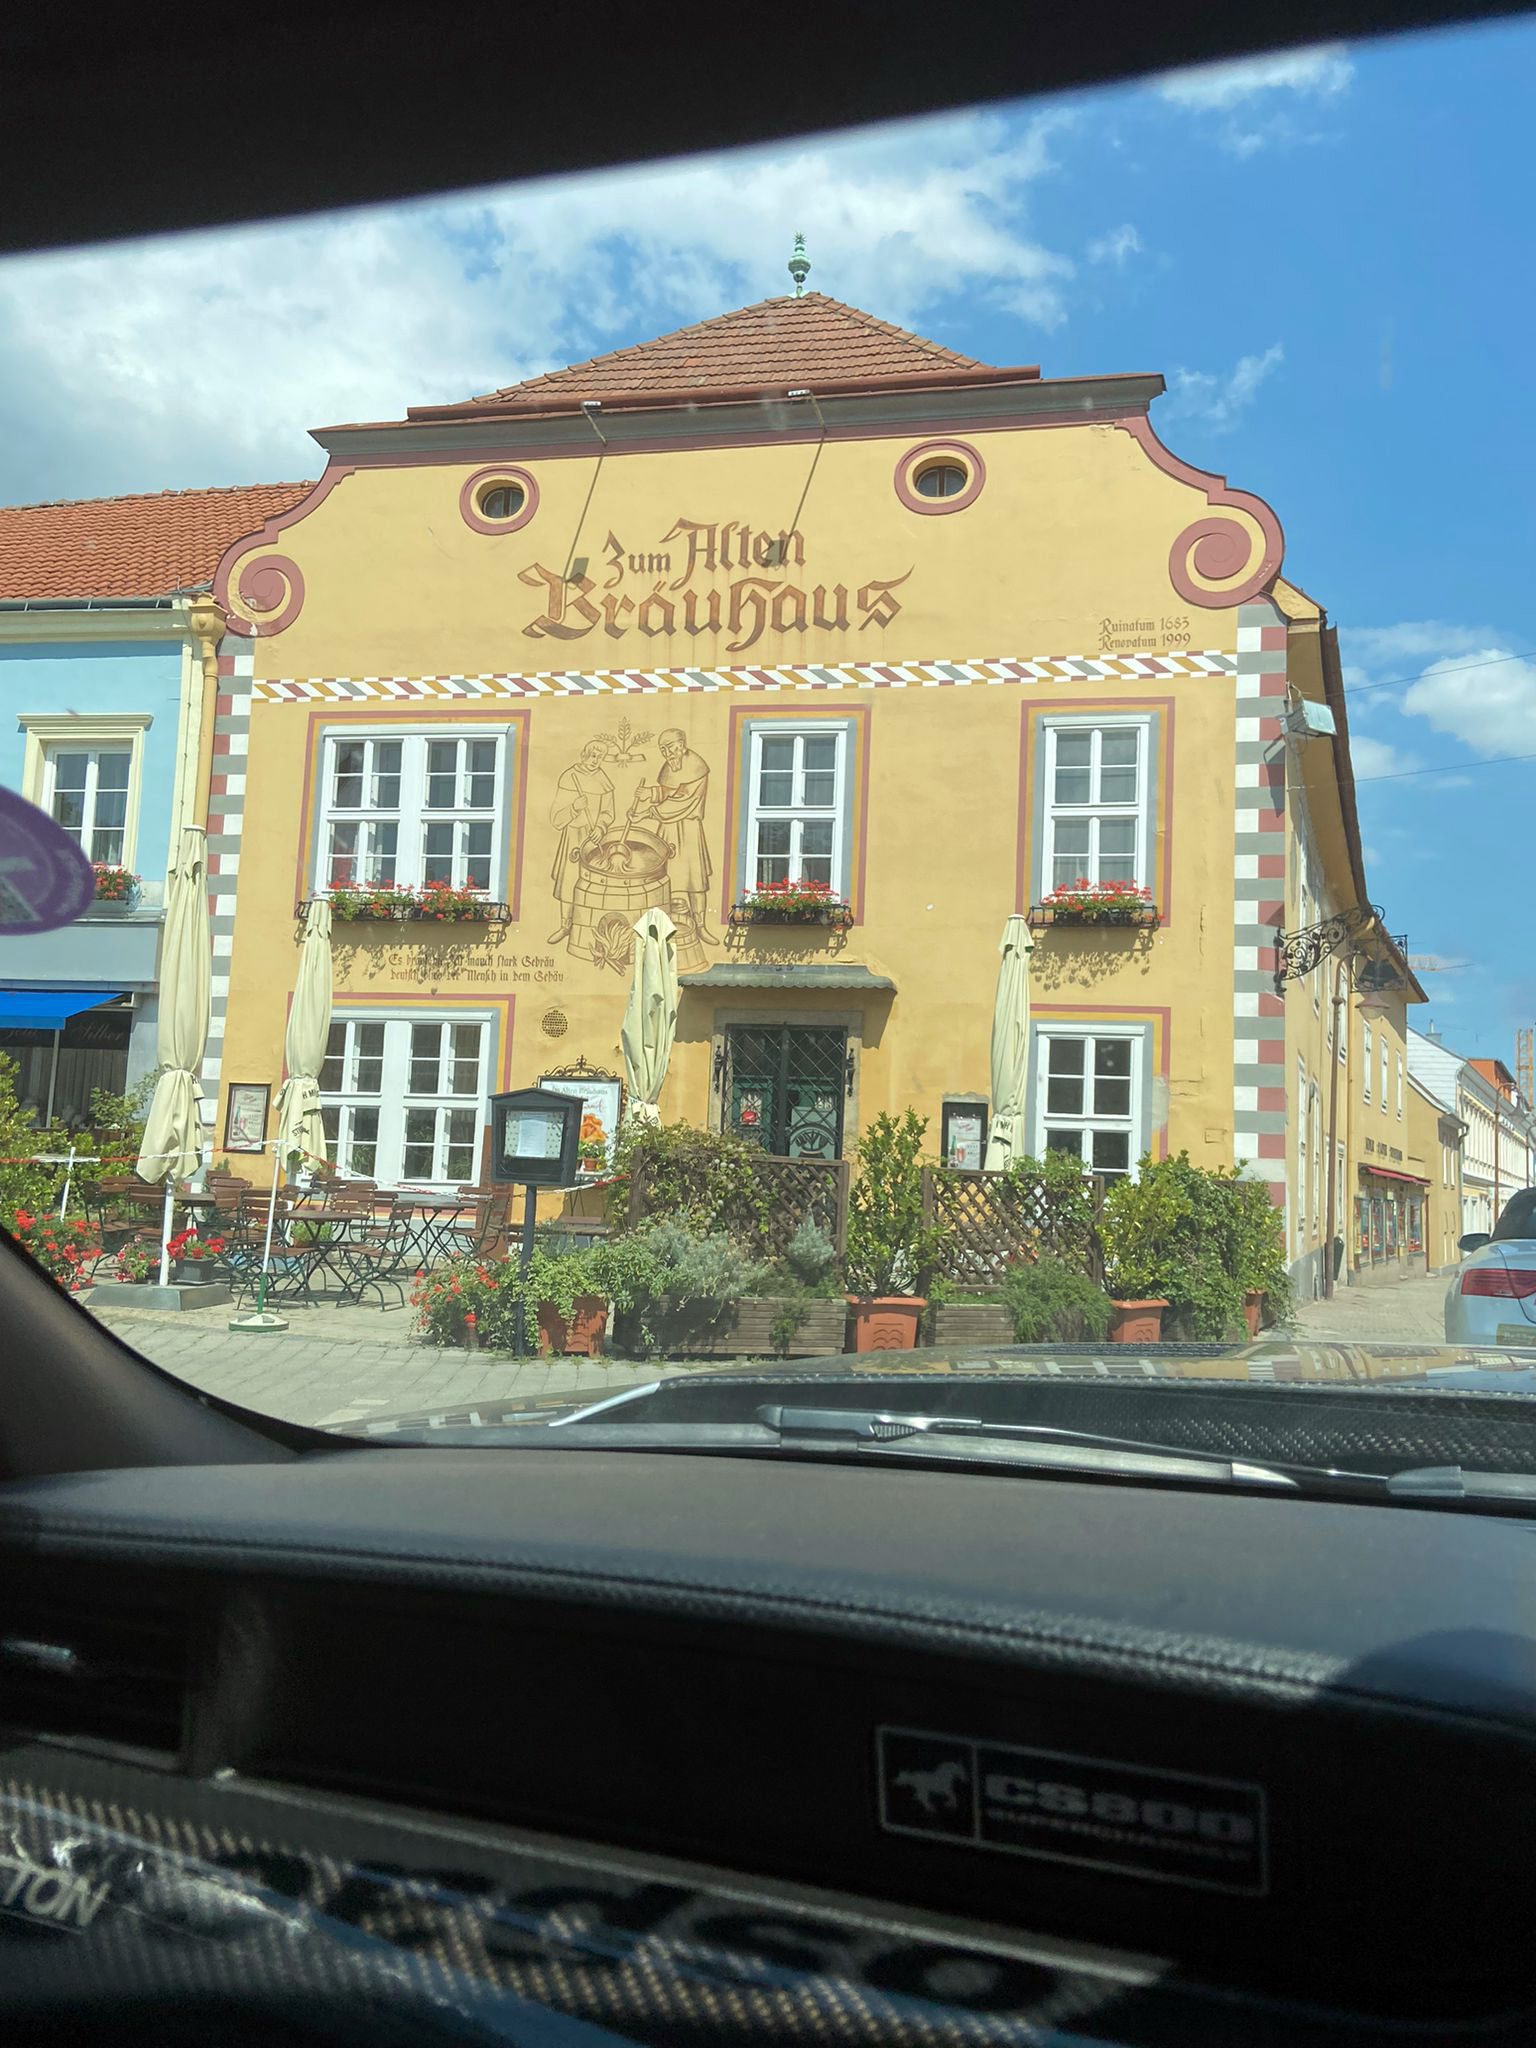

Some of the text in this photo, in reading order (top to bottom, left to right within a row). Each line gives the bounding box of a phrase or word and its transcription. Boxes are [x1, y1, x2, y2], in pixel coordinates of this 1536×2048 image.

[602, 517, 806, 591] Zum Alten
[516, 564, 915, 653] Bräuhaus
[1098, 632, 1191, 651] Renovatum 1999
[1099, 618, 1155, 635] Ruinatum
[984, 1774, 1256, 1842] CS800
